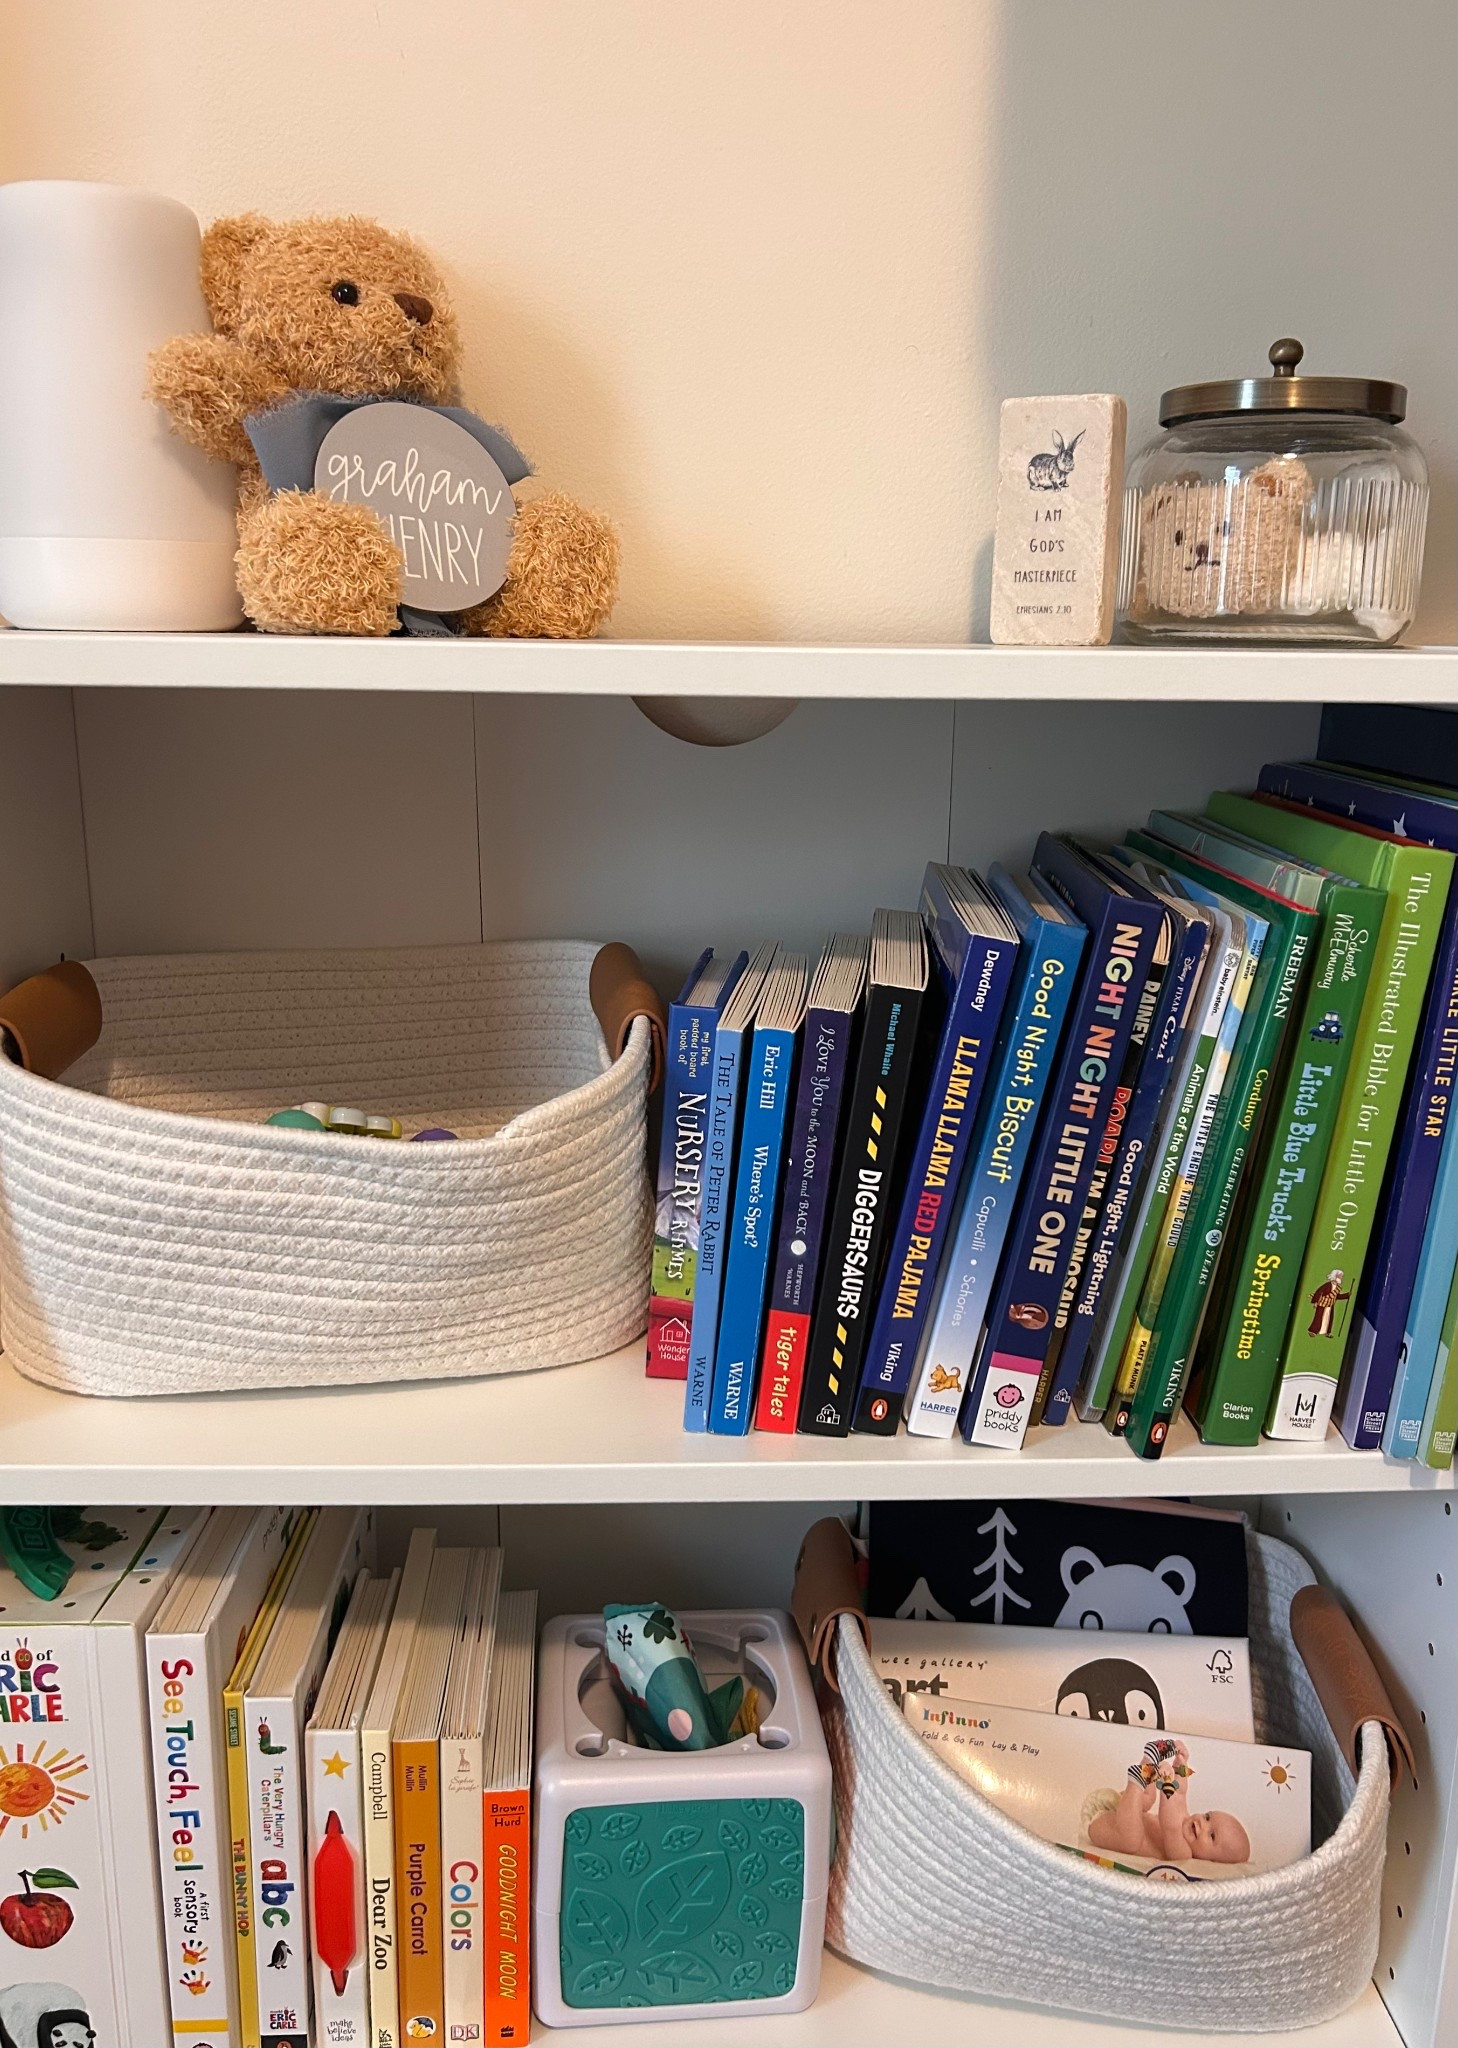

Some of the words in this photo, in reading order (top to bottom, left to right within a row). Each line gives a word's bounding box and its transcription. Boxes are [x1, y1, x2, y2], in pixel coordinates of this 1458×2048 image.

[328, 448, 502, 515] graham
[1034, 510, 1039, 522] I
[1045, 509, 1062, 522] AM
[1029, 538, 1065, 553] GOD'S
[1014, 569, 1077, 583] MASTERPIECE
[1016, 605, 1053, 614] EPHESIANS
[1404, 872, 1432, 914] The
[1316, 912, 1355, 990] McElmurry
[1340, 928, 1369, 983] Schertle
[970, 949, 1000, 1012] Dewdney
[1031, 958, 1065, 1019] Good
[1095, 923, 1143, 1020] NIGHT
[1219, 968, 1232, 987] baby
[1272, 933, 1308, 1020] FREEMAN
[1377, 920, 1421, 1035] Illustrated
[1170, 986, 1184, 1013] PIXAR
[679, 1029, 689, 1052] book
[690, 1018, 700, 1050] padded
[702, 1031, 710, 1044] my
[888, 1003, 902, 1041] Michael
[1156, 1015, 1176, 1060] Cars
[678, 1055, 687, 1065] of
[688, 1052, 697, 1078] board
[700, 1046, 712, 1066] first
[717, 1052, 736, 1088] THE
[762, 1044, 780, 1078] Eric
[881, 1041, 895, 1076] Whaite
[942, 1035, 981, 1111] LLAMA
[1010, 1025, 1048, 1089] Night,
[1068, 1024, 1116, 1119] NIGHT
[1363, 1042, 1394, 1097] Bible
[1434, 1028, 1458, 1087] LITTLE
[759, 1080, 777, 1110] Hill
[1182, 1063, 1205, 1115] Animals
[1204, 1093, 1219, 1112] THE
[1238, 1068, 1269, 1132] Corduroy
[1293, 1062, 1333, 1117] Little
[712, 1092, 733, 1137] TALE
[808, 1119, 820, 1132] the
[810, 1108, 820, 1120] to
[1176, 1116, 1187, 1131] of
[1195, 1114, 1213, 1148] LITTLE
[1357, 1102, 1380, 1133] for
[1424, 1094, 1447, 1137] STAR
[672, 1091, 708, 1214] NURSERY
[712, 1143, 724, 1161] OF
[803, 1136, 818, 1179] MOON
[924, 1114, 962, 1188] LLAMA
[986, 1095, 1035, 1184] Biscuit
[1169, 1131, 1184, 1152] the
[1283, 1121, 1318, 1162] Blue
[749, 1145, 770, 1203] Where's
[1046, 1123, 1090, 1205] LITTLE
[1118, 1139, 1143, 1186] Good
[1156, 1156, 1179, 1195] World
[1184, 1151, 1203, 1187] ENGINE
[1343, 1138, 1372, 1194] Little
[706, 1164, 725, 1214] PETER
[800, 1179, 810, 1198] and
[1087, 1169, 1107, 1199] I'M
[1176, 1188, 1192, 1214] THAT
[1215, 1147, 1245, 1226] CELEBRATING
[795, 1200, 810, 1236] BACK
[914, 1190, 942, 1233] RED
[970, 1195, 996, 1252] Capucilli
[1081, 1205, 1097, 1220] A
[1103, 1189, 1129, 1236] Night,
[1264, 1168, 1306, 1242] Truck's
[743, 1205, 762, 1248] Spot?
[836, 1168, 883, 1320] DIGGERSAURS
[1028, 1212, 1066, 1275] ONE
[1167, 1216, 1185, 1248] COULD
[1210, 1232, 1220, 1244] 50
[1330, 1200, 1359, 1252] Ones
[667, 1220, 688, 1280] RHYMES
[701, 1219, 721, 1275] RABBIT
[892, 1233, 932, 1320] PAJAMA
[1078, 1240, 1112, 1316] Lightning
[1198, 1249, 1216, 1286] YEARS
[951, 1274, 976, 1327] Schories
[1236, 1253, 1281, 1361] Springtime
[657, 1343, 691, 1355] Wonder
[660, 1352, 687, 1362] House
[776, 1326, 798, 1371] tiger
[879, 1342, 903, 1382] Viking
[1137, 1340, 1147, 1361] PLATT
[691, 1356, 707, 1407] WARNE
[723, 1361, 744, 1420] WARNE
[770, 1374, 791, 1419] tales
[1033, 1368, 1049, 1404] HARPER
[1128, 1367, 1140, 1390] MUNK
[1162, 1357, 1185, 1408] VIKING
[920, 1401, 957, 1414] HARPER
[984, 1418, 1019, 1433] books
[985, 1408, 1023, 1426] priddy
[1222, 1402, 1254, 1413] Clarion
[1222, 1410, 1250, 1421] Books
[36, 1650, 53, 1661] of
[881, 1656, 910, 1665] wee
[161, 1658, 194, 1719] See,
[1211, 1674, 1234, 1684] FSC
[923, 1708, 990, 1729] Infinno
[165, 1719, 200, 1804] Touch,
[921, 1731, 939, 1741] Fold
[953, 1735, 965, 1744] Go
[968, 1737, 985, 1747] Fun
[991, 1740, 1007, 1752] Lay
[1010, 1743, 1018, 1751] &
[1021, 1744, 1040, 1756] Play
[273, 1766, 284, 1784] The
[368, 1752, 388, 1821] Campbell
[405, 1765, 414, 1792] Mullin
[418, 1765, 428, 1791] Mullin
[260, 1779, 274, 1842] Caterpillar's
[271, 1787, 284, 1811] Very
[491, 1803, 525, 1813] Brown
[169, 1809, 204, 1871] Feel
[273, 1813, 285, 1849] Hungry
[494, 1816, 521, 1828] Hurd
[232, 1838, 245, 1862] THE
[234, 1864, 248, 1909] BUNNY
[406, 1843, 427, 1897] Purple
[173, 1896, 183, 1918] book
[183, 1879, 198, 1934] sensory
[199, 1902, 210, 1921] first
[260, 1859, 295, 1929] abc
[372, 1877, 391, 1929] Dear
[450, 1860, 479, 1951] Colors
[498, 1844, 518, 1944] GOODNIGHT
[237, 1910, 250, 1937] HOP
[410, 1901, 428, 1956] Carrot
[374, 1934, 392, 1970] Zoo
[498, 1950, 518, 2000] MOON
[269, 2021, 298, 2030] CARLE
[327, 2026, 357, 2036] believe
[329, 2019, 353, 2028] make
[331, 2033, 354, 2042] ideas
